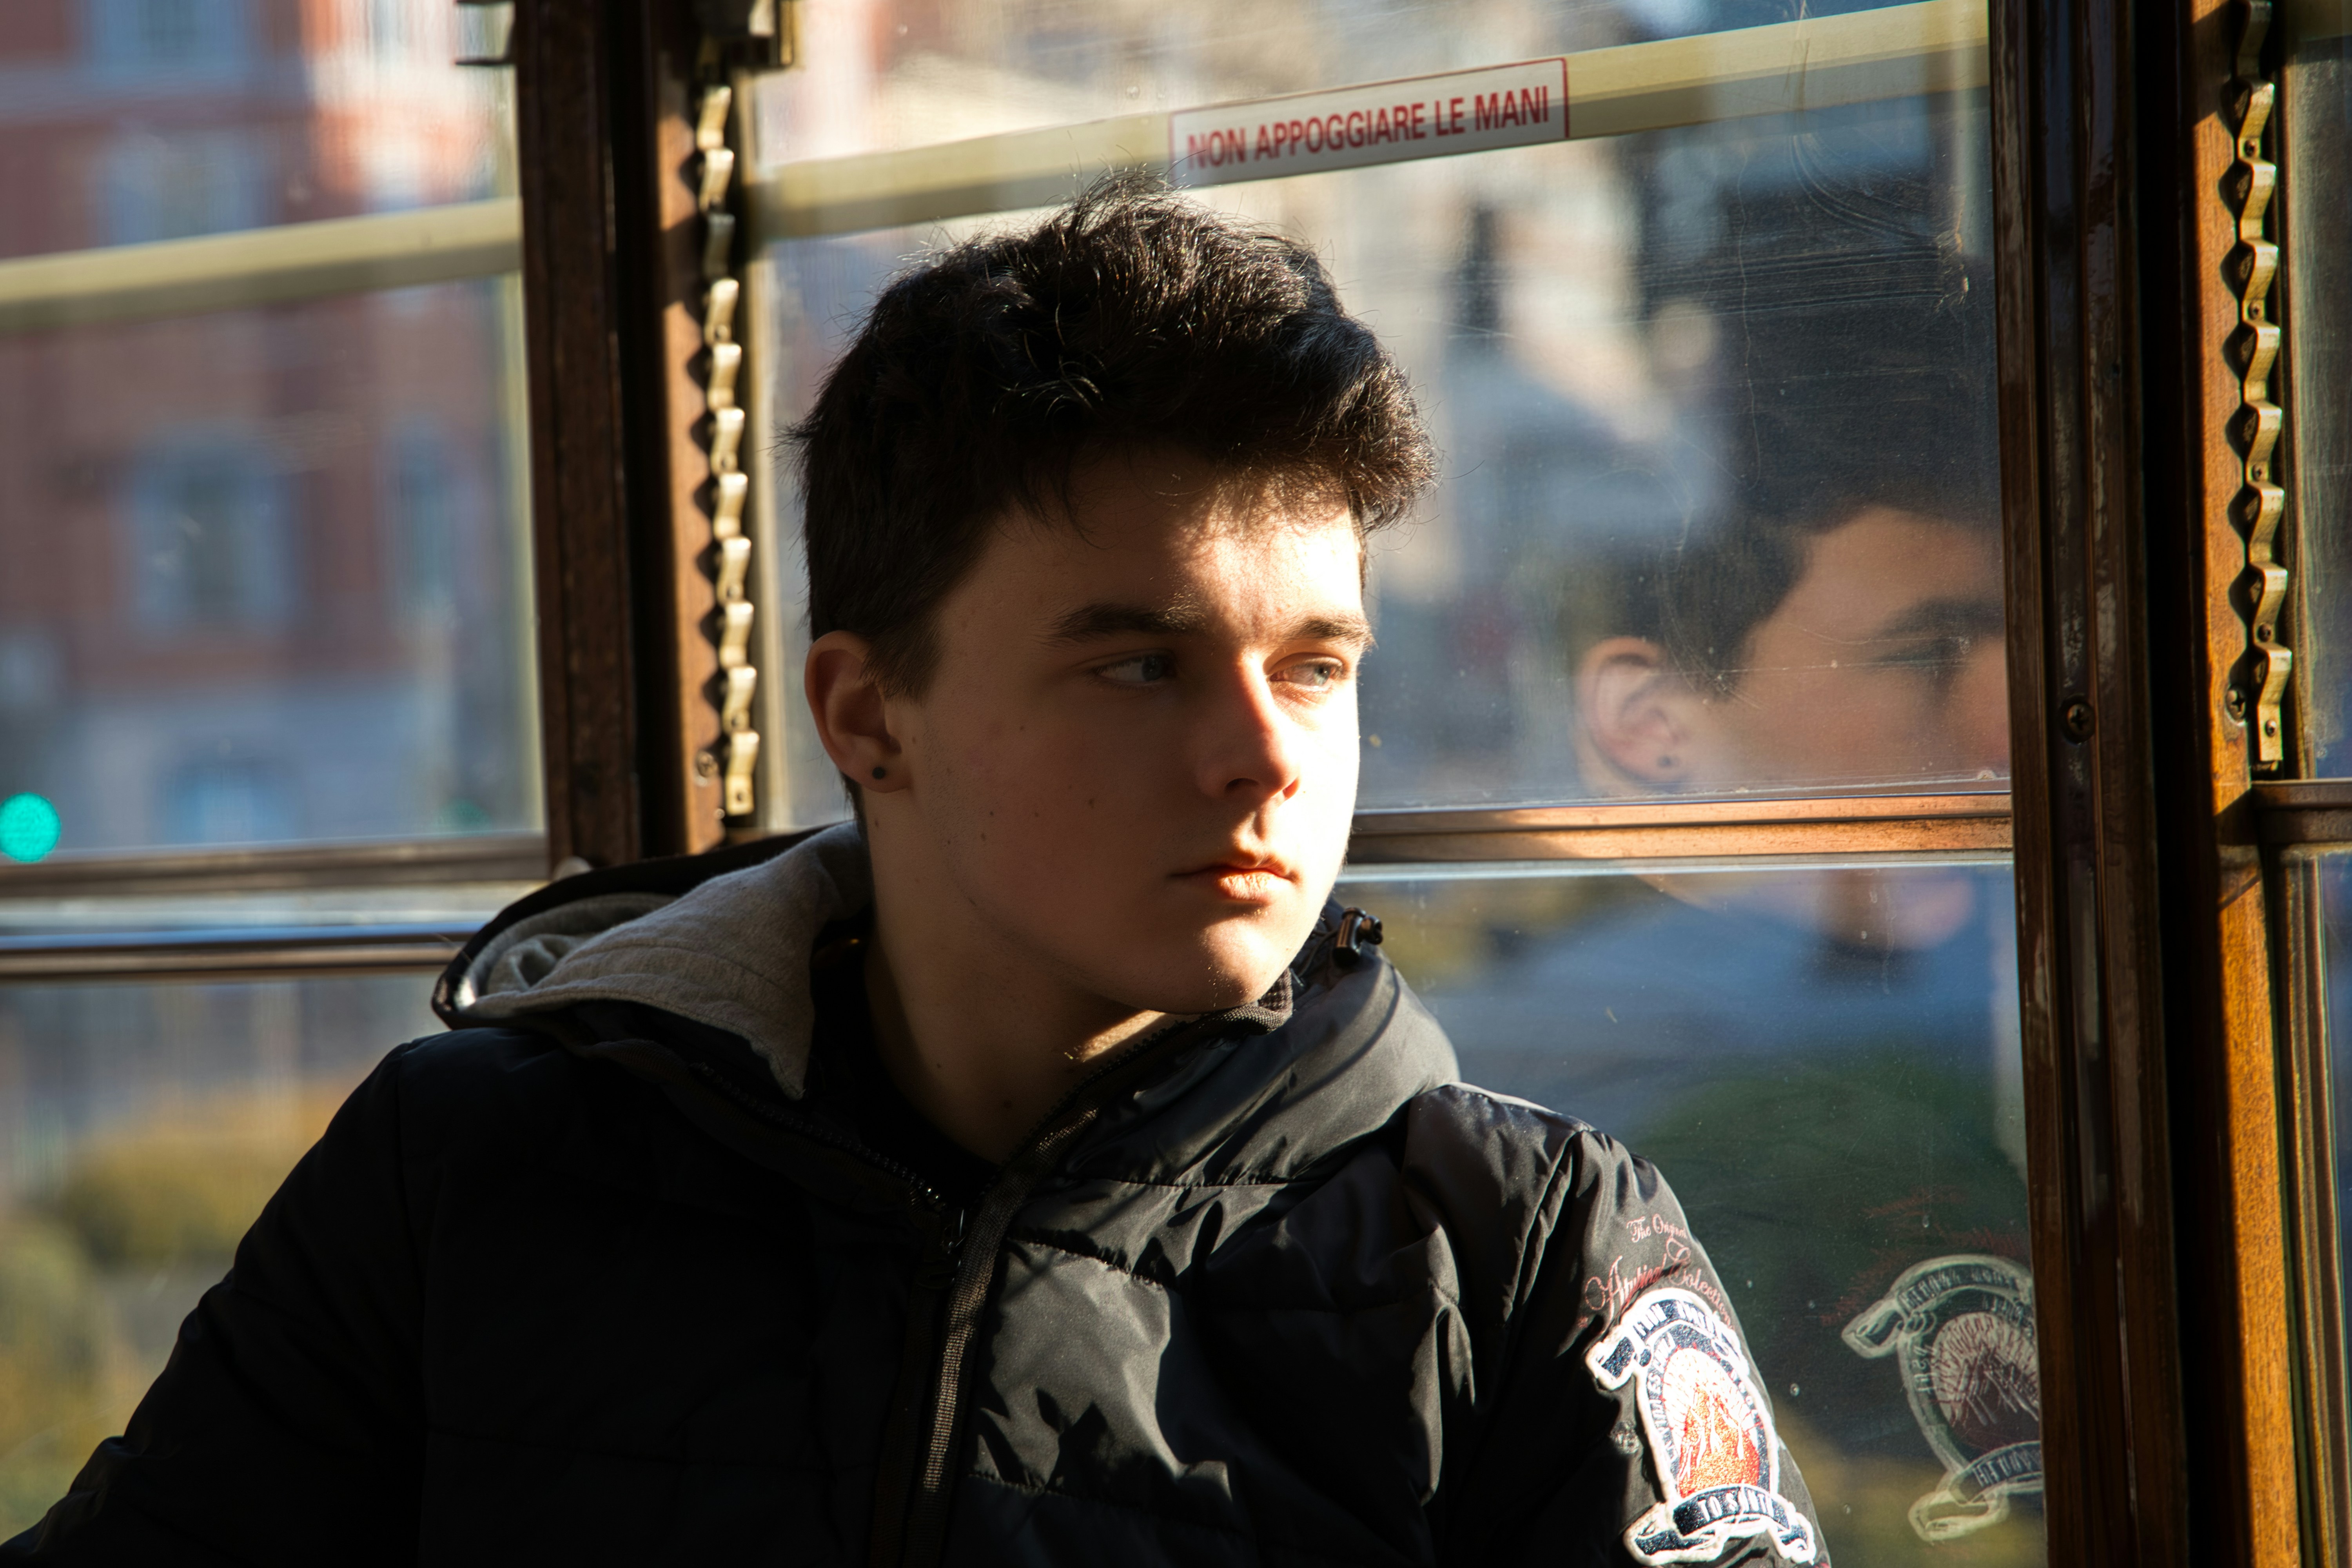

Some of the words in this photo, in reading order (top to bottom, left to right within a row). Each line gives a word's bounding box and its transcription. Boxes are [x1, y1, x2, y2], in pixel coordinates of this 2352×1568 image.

[1187, 127, 1247, 169] NON
[1255, 103, 1426, 160] APPOGGIARE
[1435, 97, 1465, 137] LE
[1475, 85, 1549, 131] MANI
[1626, 1216, 1651, 1243] The
